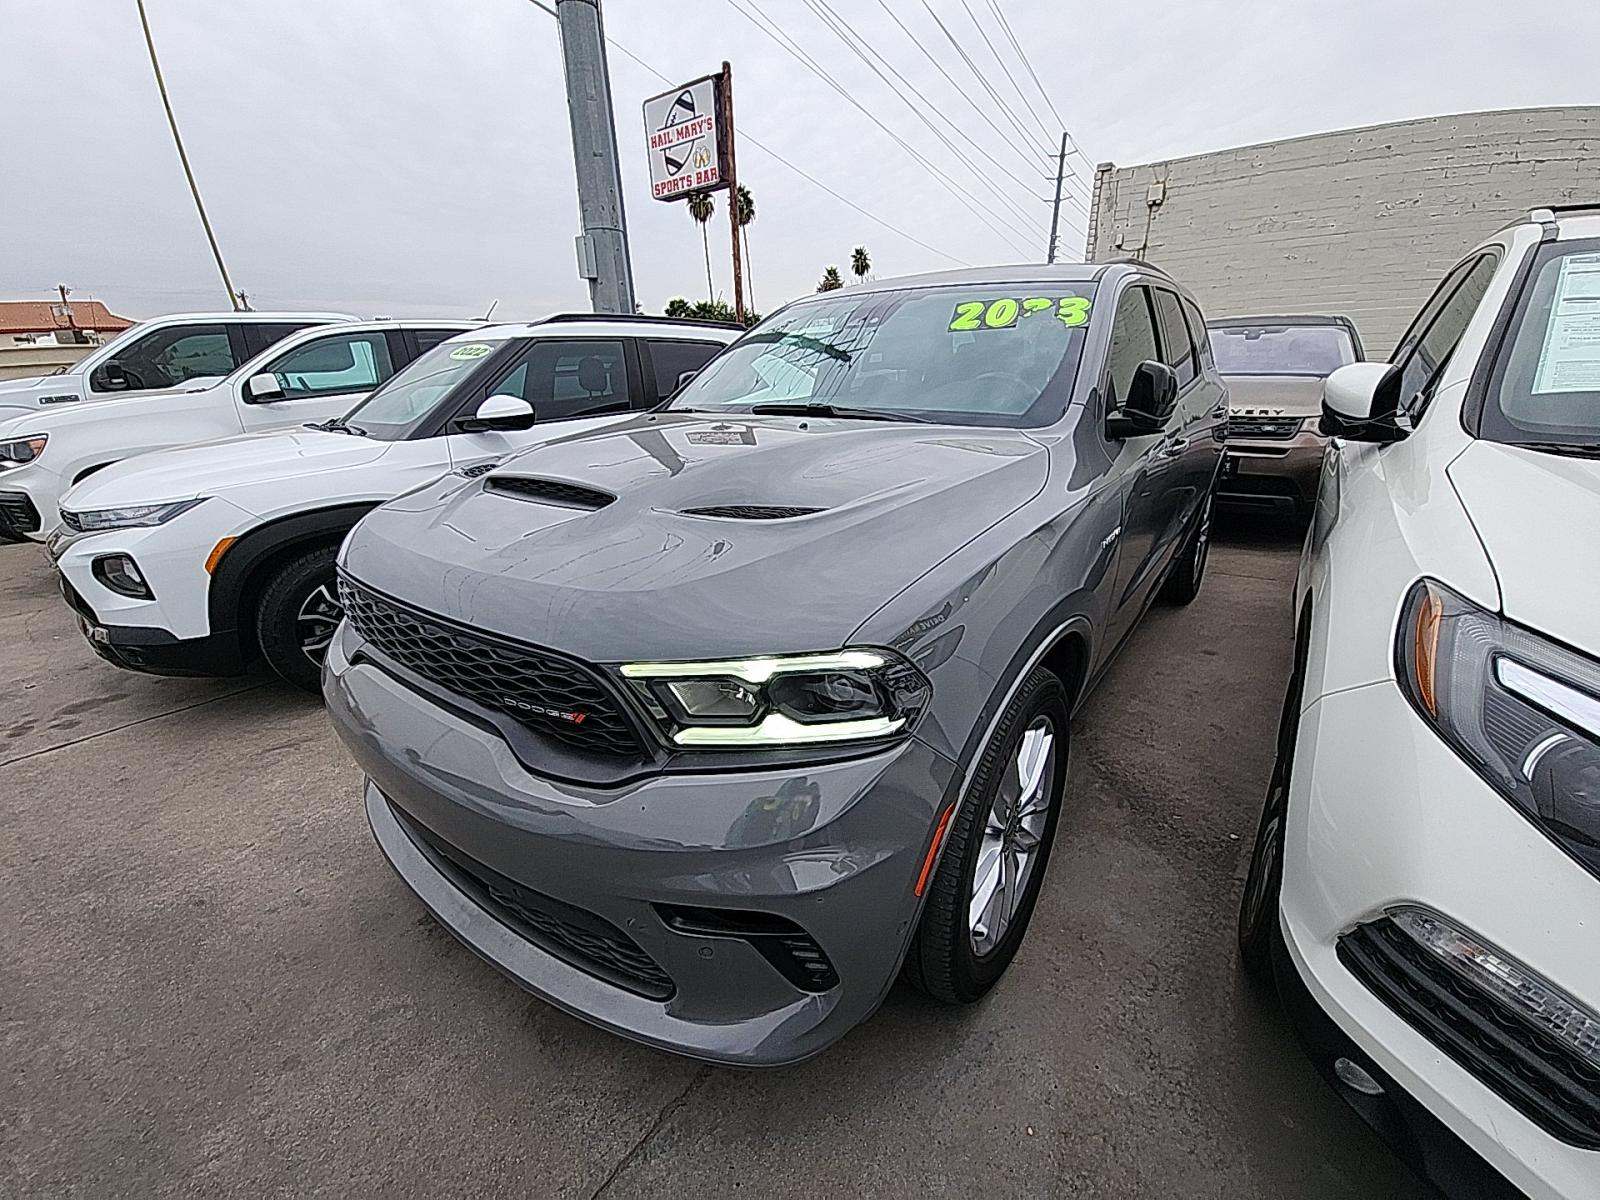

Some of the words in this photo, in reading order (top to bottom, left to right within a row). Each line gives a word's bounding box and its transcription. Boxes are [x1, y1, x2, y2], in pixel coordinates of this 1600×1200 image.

[651, 131, 673, 149] HAIL
[675, 117, 713, 140] MARY'S
[654, 174, 692, 196] SPORTS
[696, 167, 718, 184] BAR
[503, 697, 575, 720] DODGE
